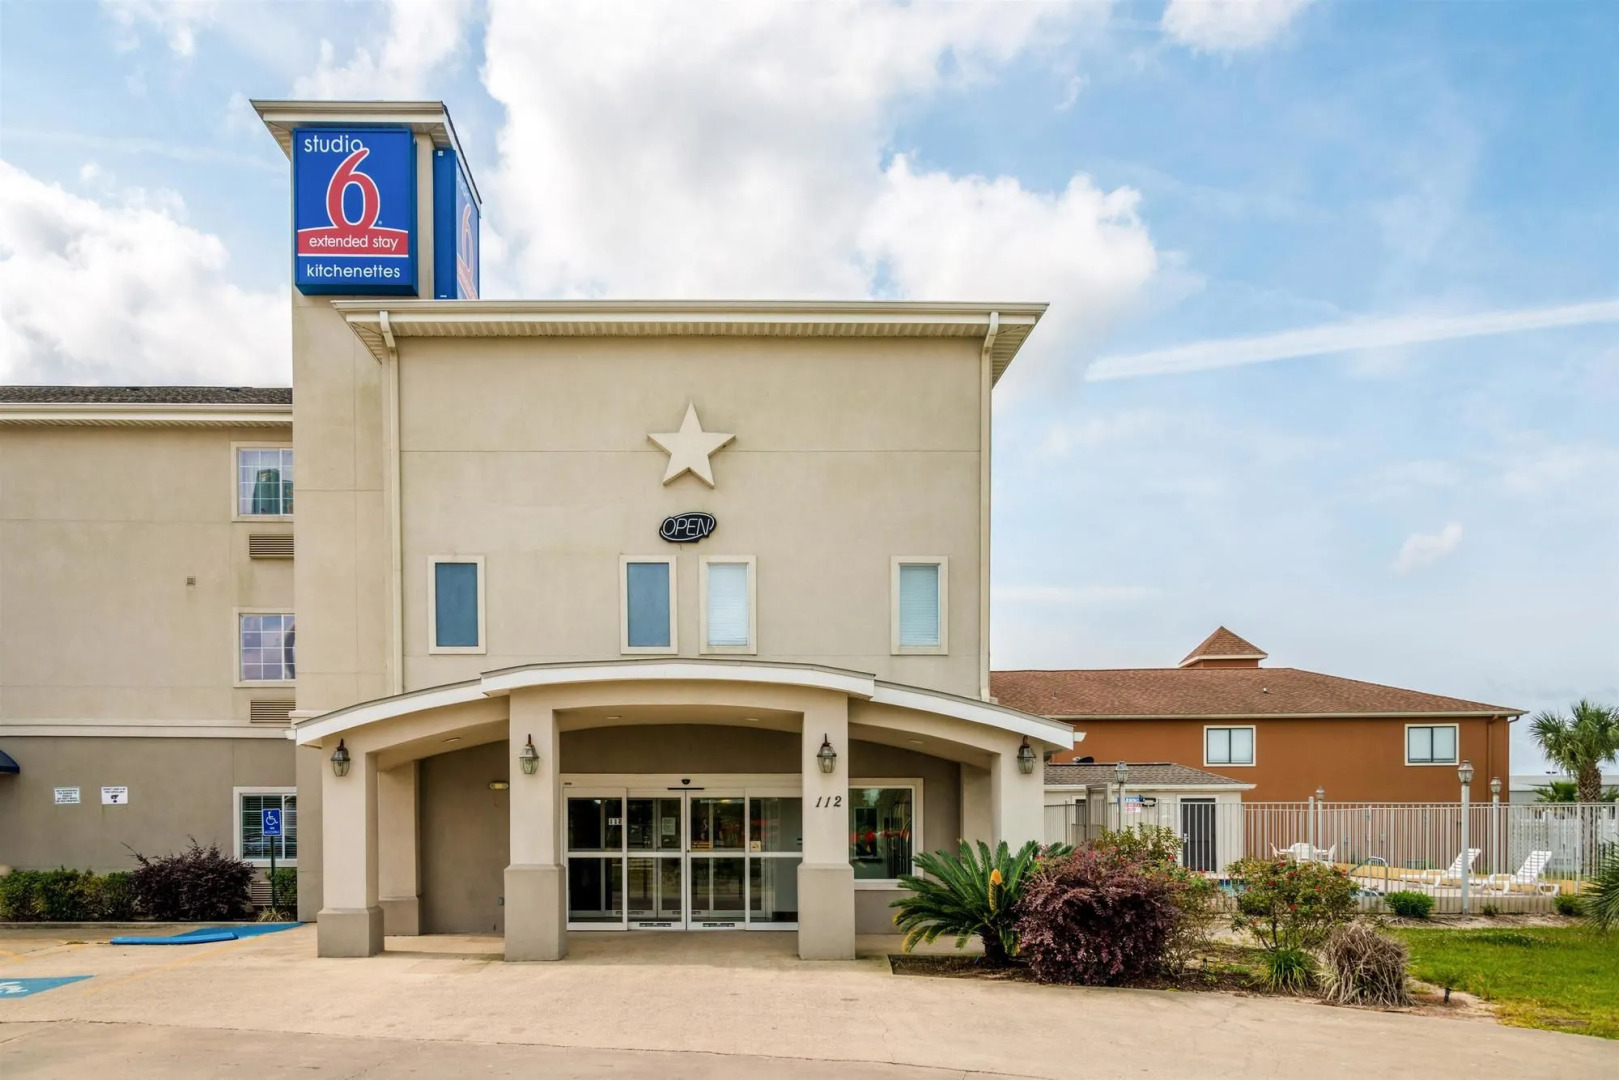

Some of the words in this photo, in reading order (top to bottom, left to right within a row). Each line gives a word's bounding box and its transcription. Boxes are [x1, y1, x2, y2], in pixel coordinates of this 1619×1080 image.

[304, 135, 363, 153] studio
[326, 148, 381, 228] 6
[309, 235, 368, 248] extended
[372, 236, 399, 251] stay
[306, 264, 401, 278] kitchenettes
[662, 518, 710, 536] OPEN
[815, 795, 842, 808] 112
